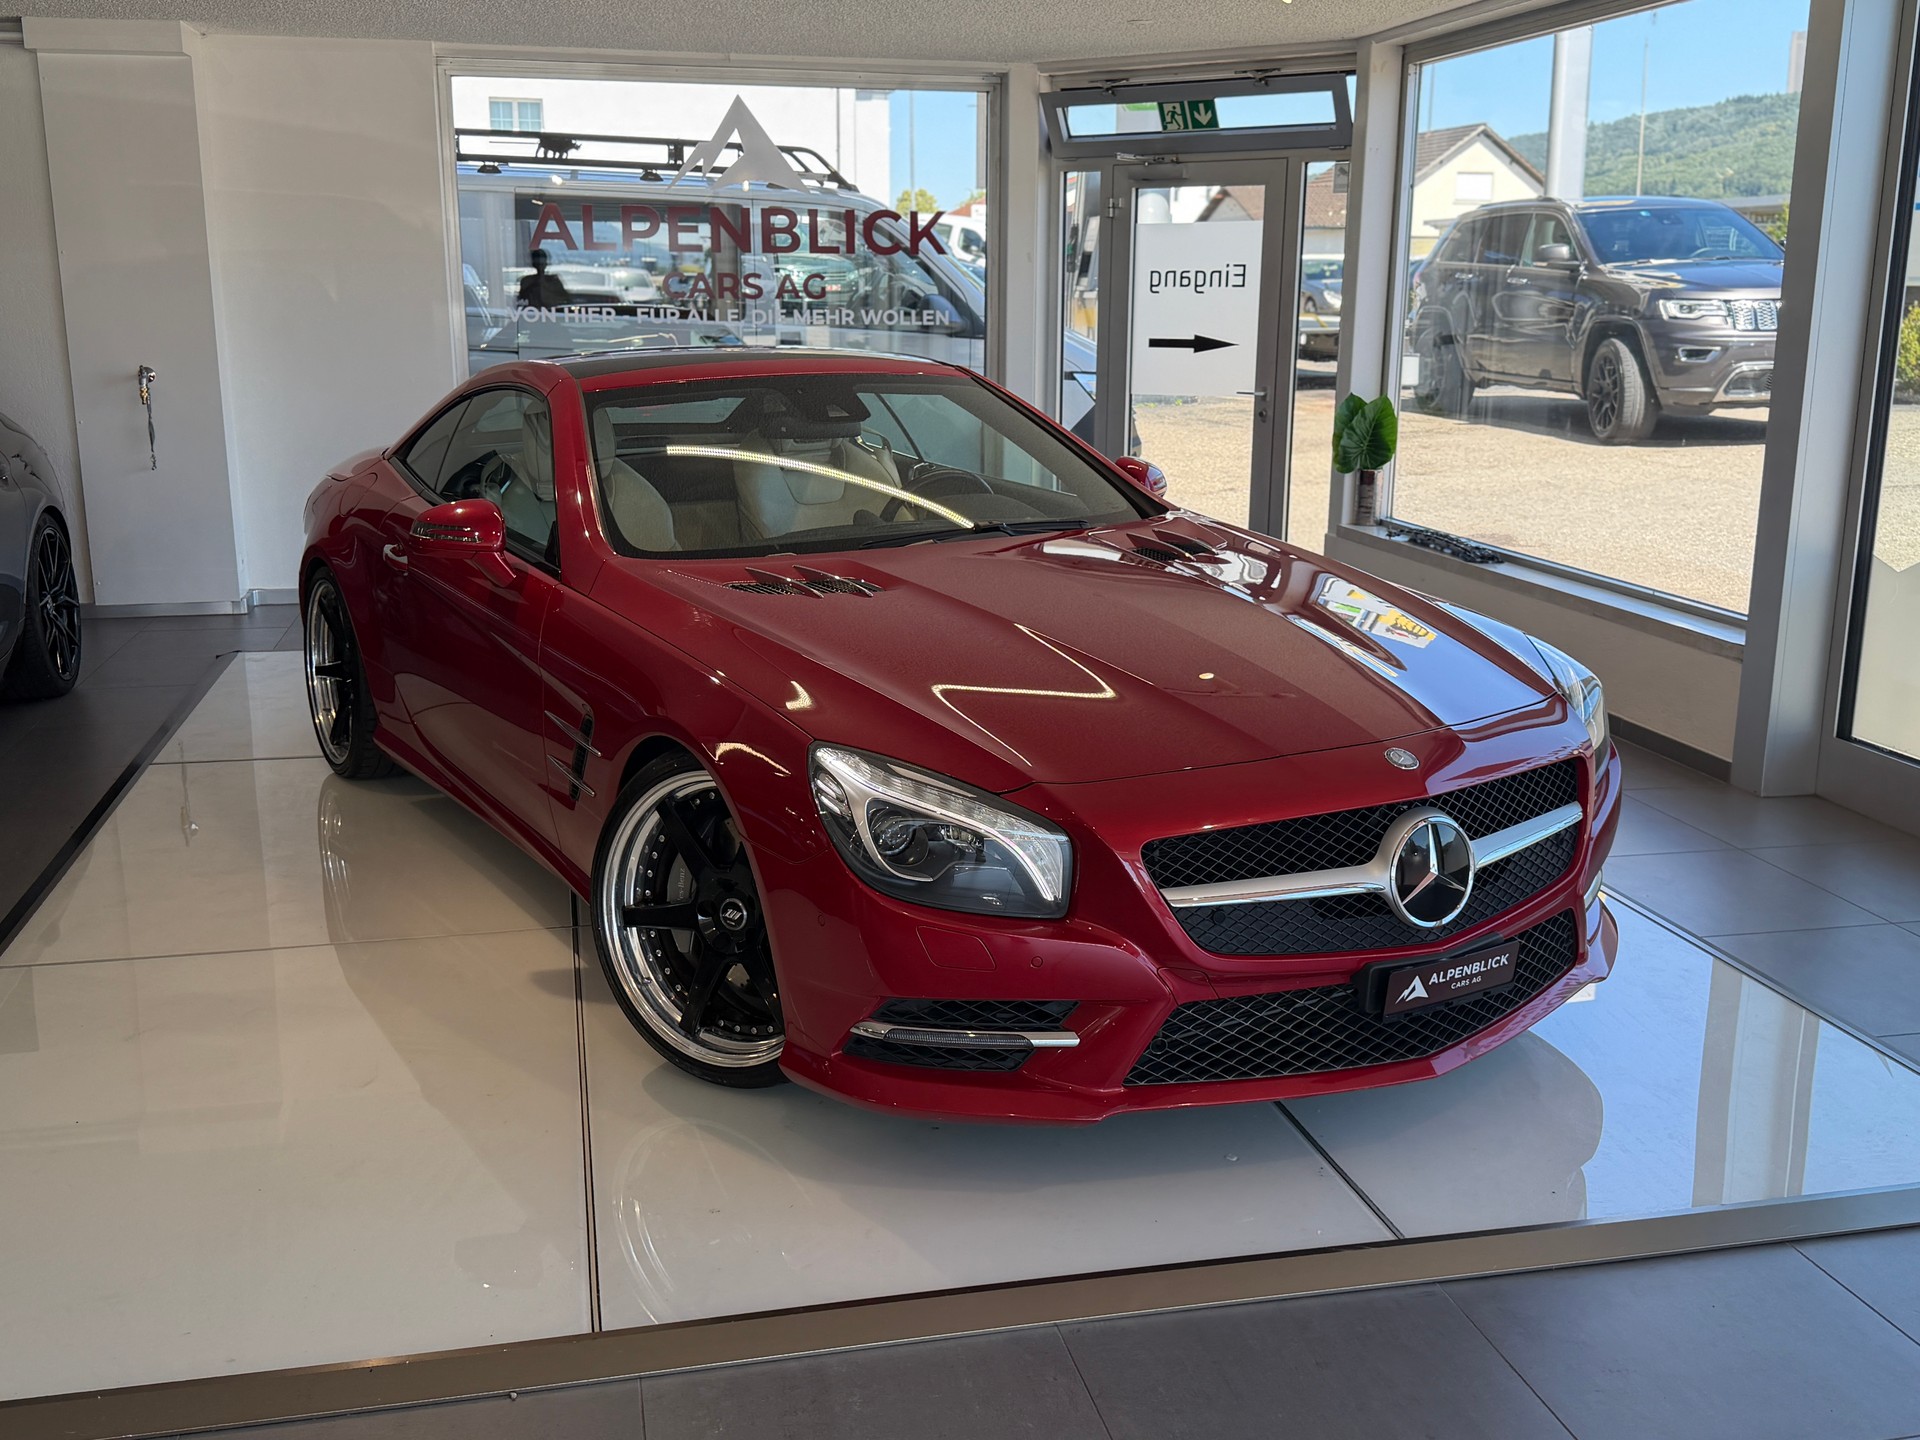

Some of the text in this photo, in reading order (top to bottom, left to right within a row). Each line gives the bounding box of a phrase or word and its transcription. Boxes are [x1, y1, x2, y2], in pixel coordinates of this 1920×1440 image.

[529, 202, 947, 256] ALPENBLICK
[661, 271, 828, 301] CARS AG
[508, 306, 557, 323] VON
[564, 306, 617, 324] HIER
[752, 309, 787, 326] DIE
[793, 309, 855, 326] MEHR
[860, 309, 950, 326] WOLLEN
[1428, 953, 1510, 985] ALPENBLICK
[1450, 975, 1482, 991] CARS AG
